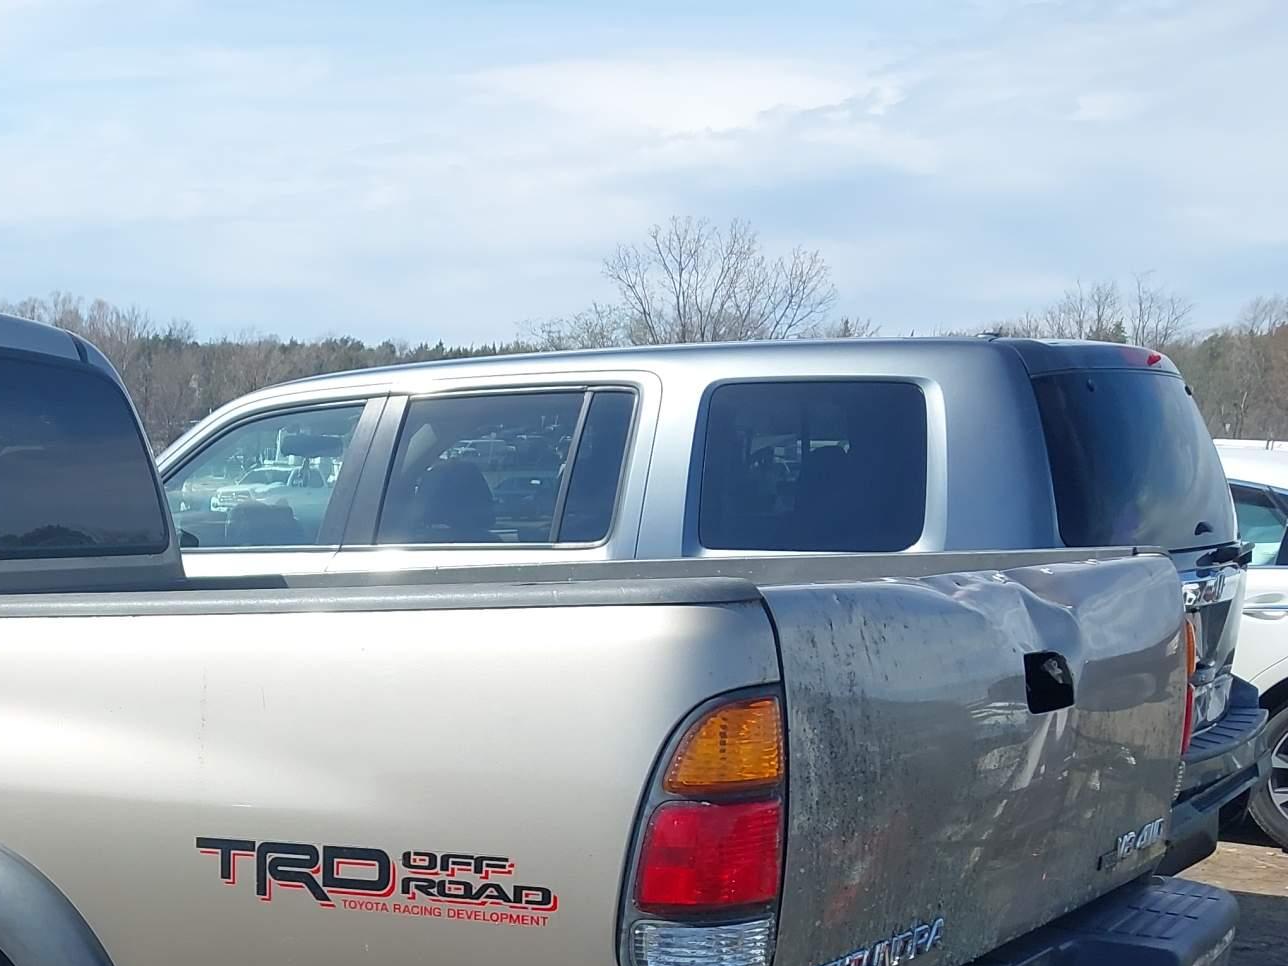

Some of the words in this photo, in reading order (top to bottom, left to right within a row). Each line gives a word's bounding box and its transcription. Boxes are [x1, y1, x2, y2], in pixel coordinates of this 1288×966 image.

[196, 837, 396, 908] TRD
[401, 850, 515, 880] OFF
[401, 876, 559, 912] ROAD
[341, 899, 389, 914] TOYOTA
[393, 903, 442, 919] RACING
[447, 907, 550, 928] DEVELOPMENT
